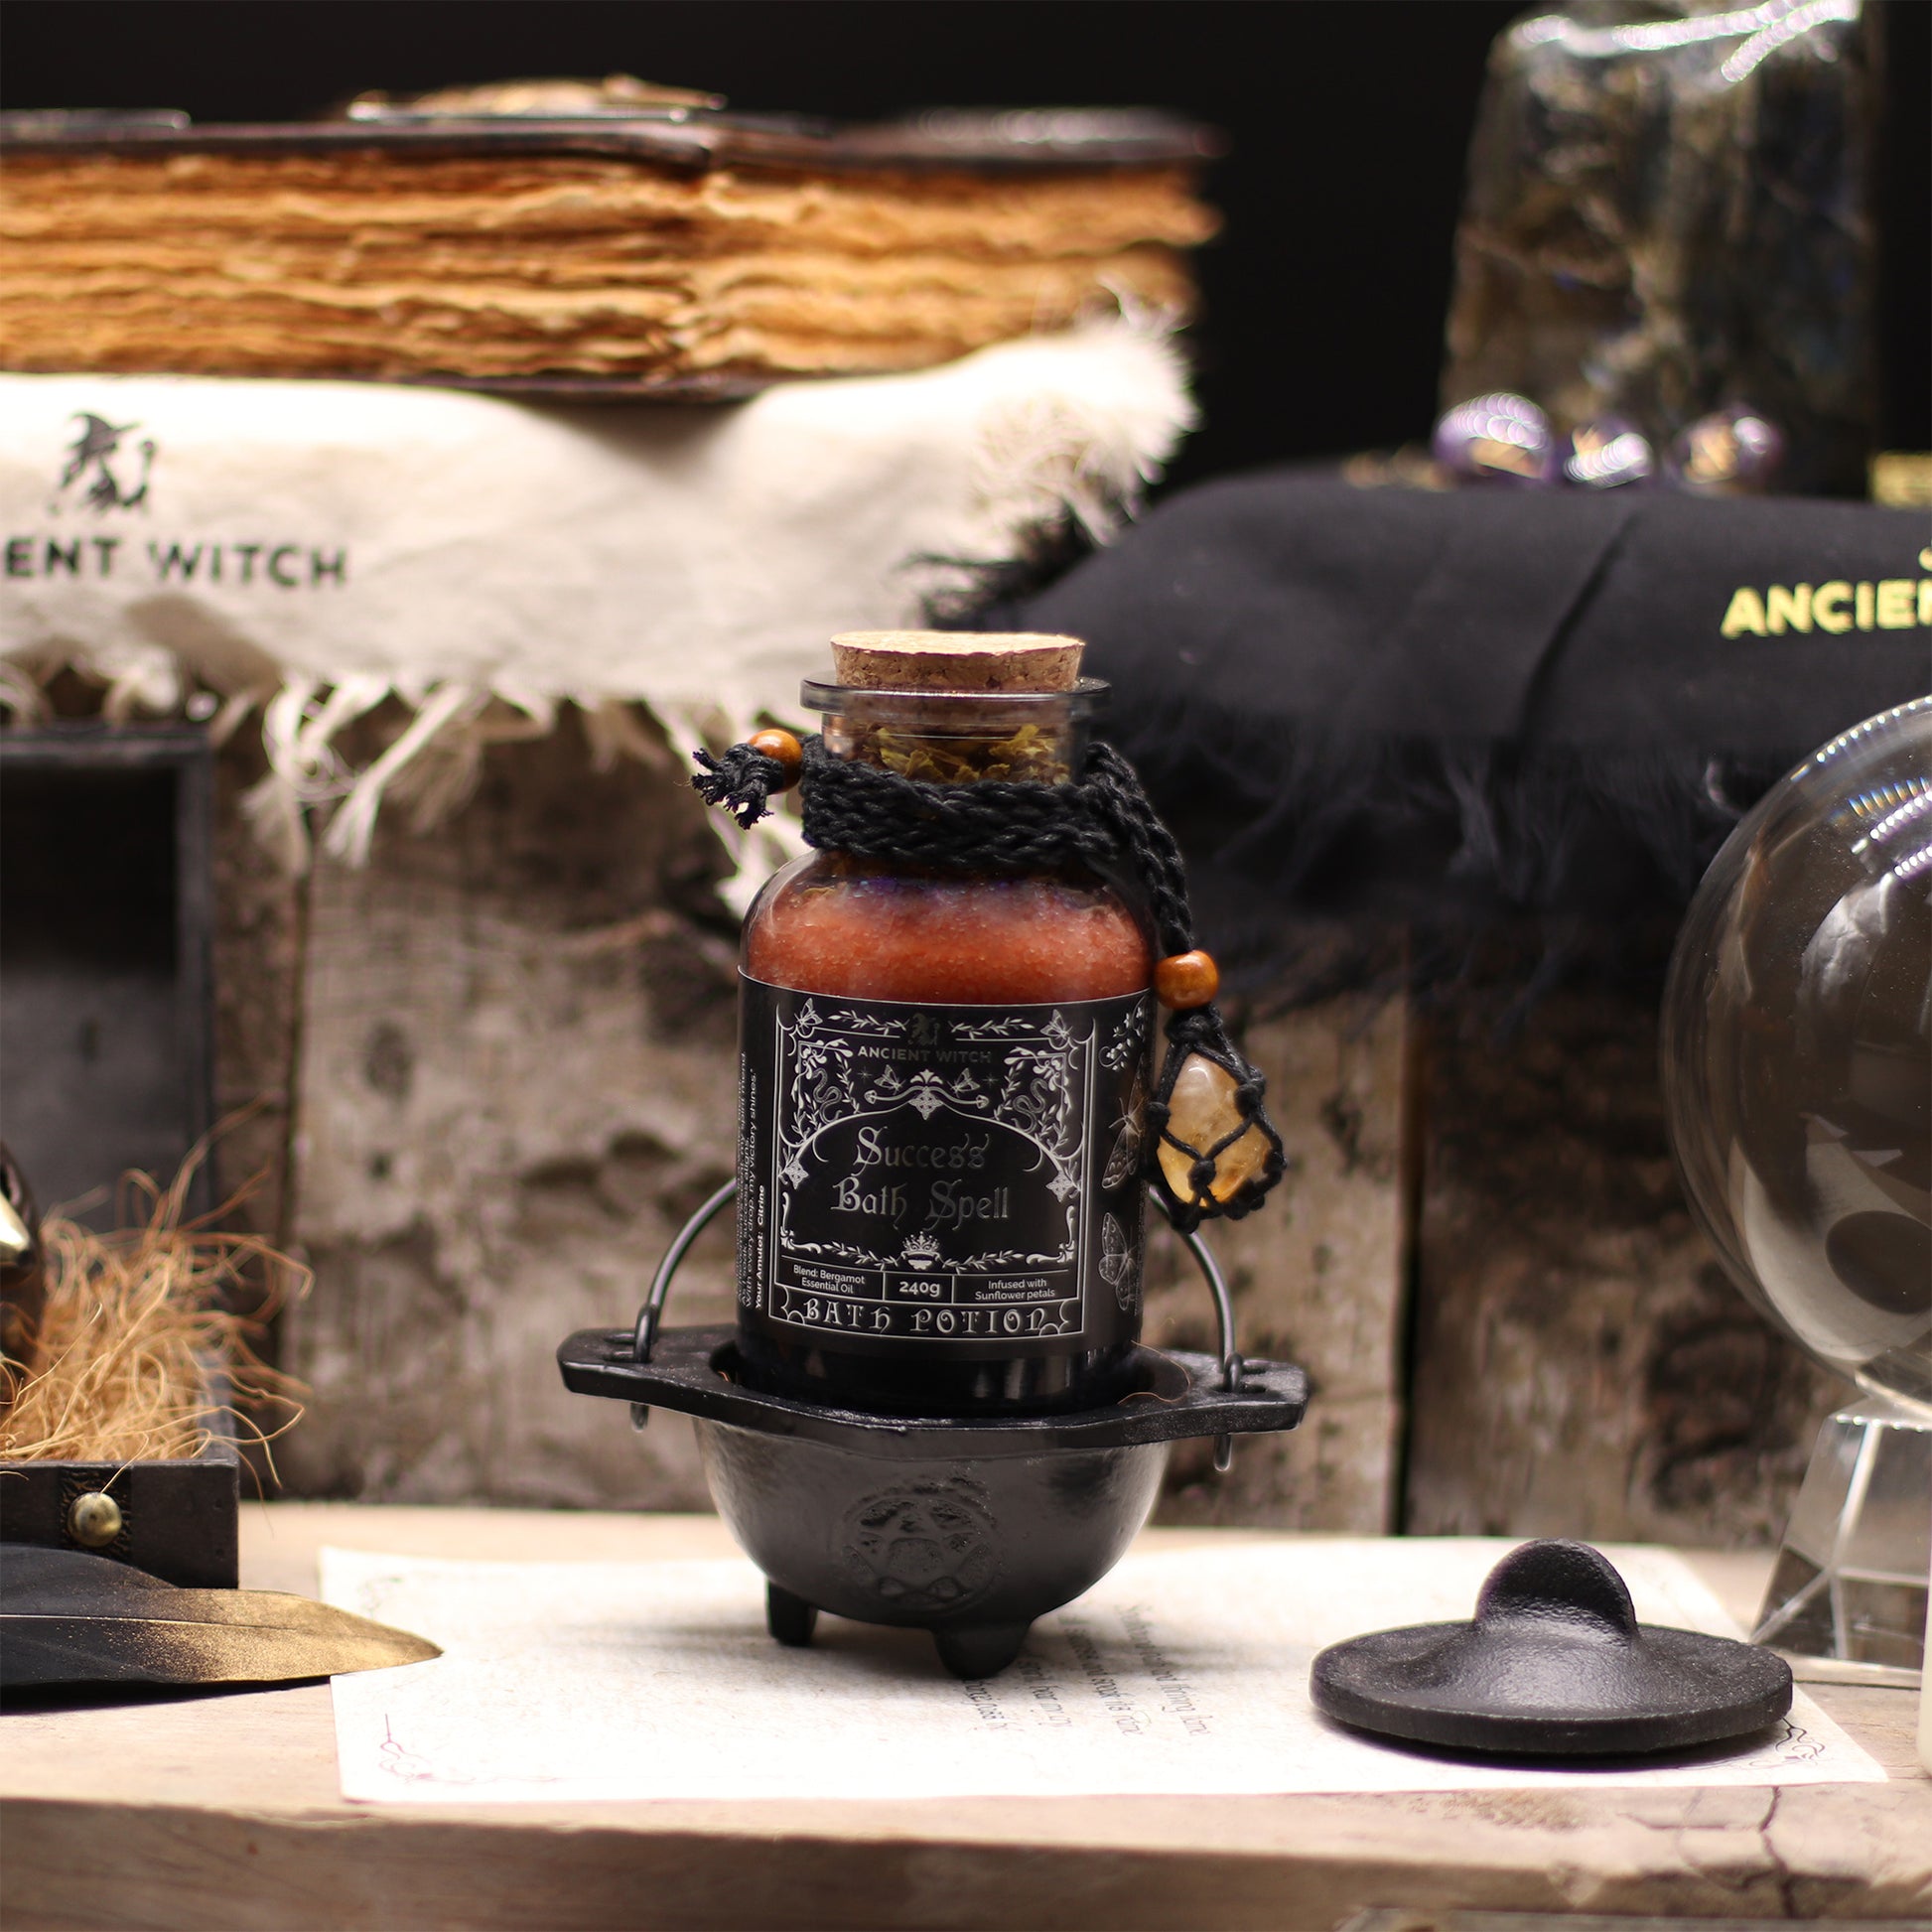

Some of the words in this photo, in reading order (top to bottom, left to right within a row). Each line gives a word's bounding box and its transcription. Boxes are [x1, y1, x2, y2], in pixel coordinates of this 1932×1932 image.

[146, 542, 347, 588] WITCH
[857, 1045, 930, 1062] ANCIENT
[935, 1050, 992, 1063] WITCH
[851, 1126, 990, 1176] Success
[750, 1170, 756, 1192] my
[830, 1176, 908, 1230] Bath
[922, 1178, 1009, 1231] Spell
[793, 1264, 818, 1278] Blend:
[820, 1269, 866, 1285] Bergamot
[988, 1279, 1026, 1290] Infused
[1026, 1278, 1047, 1289] with
[801, 1277, 840, 1292] Essential
[840, 1283, 854, 1294] Oil
[898, 1281, 940, 1298] 240g
[975, 1290, 1026, 1301] Sunflower
[1027, 1289, 1055, 1301] petals
